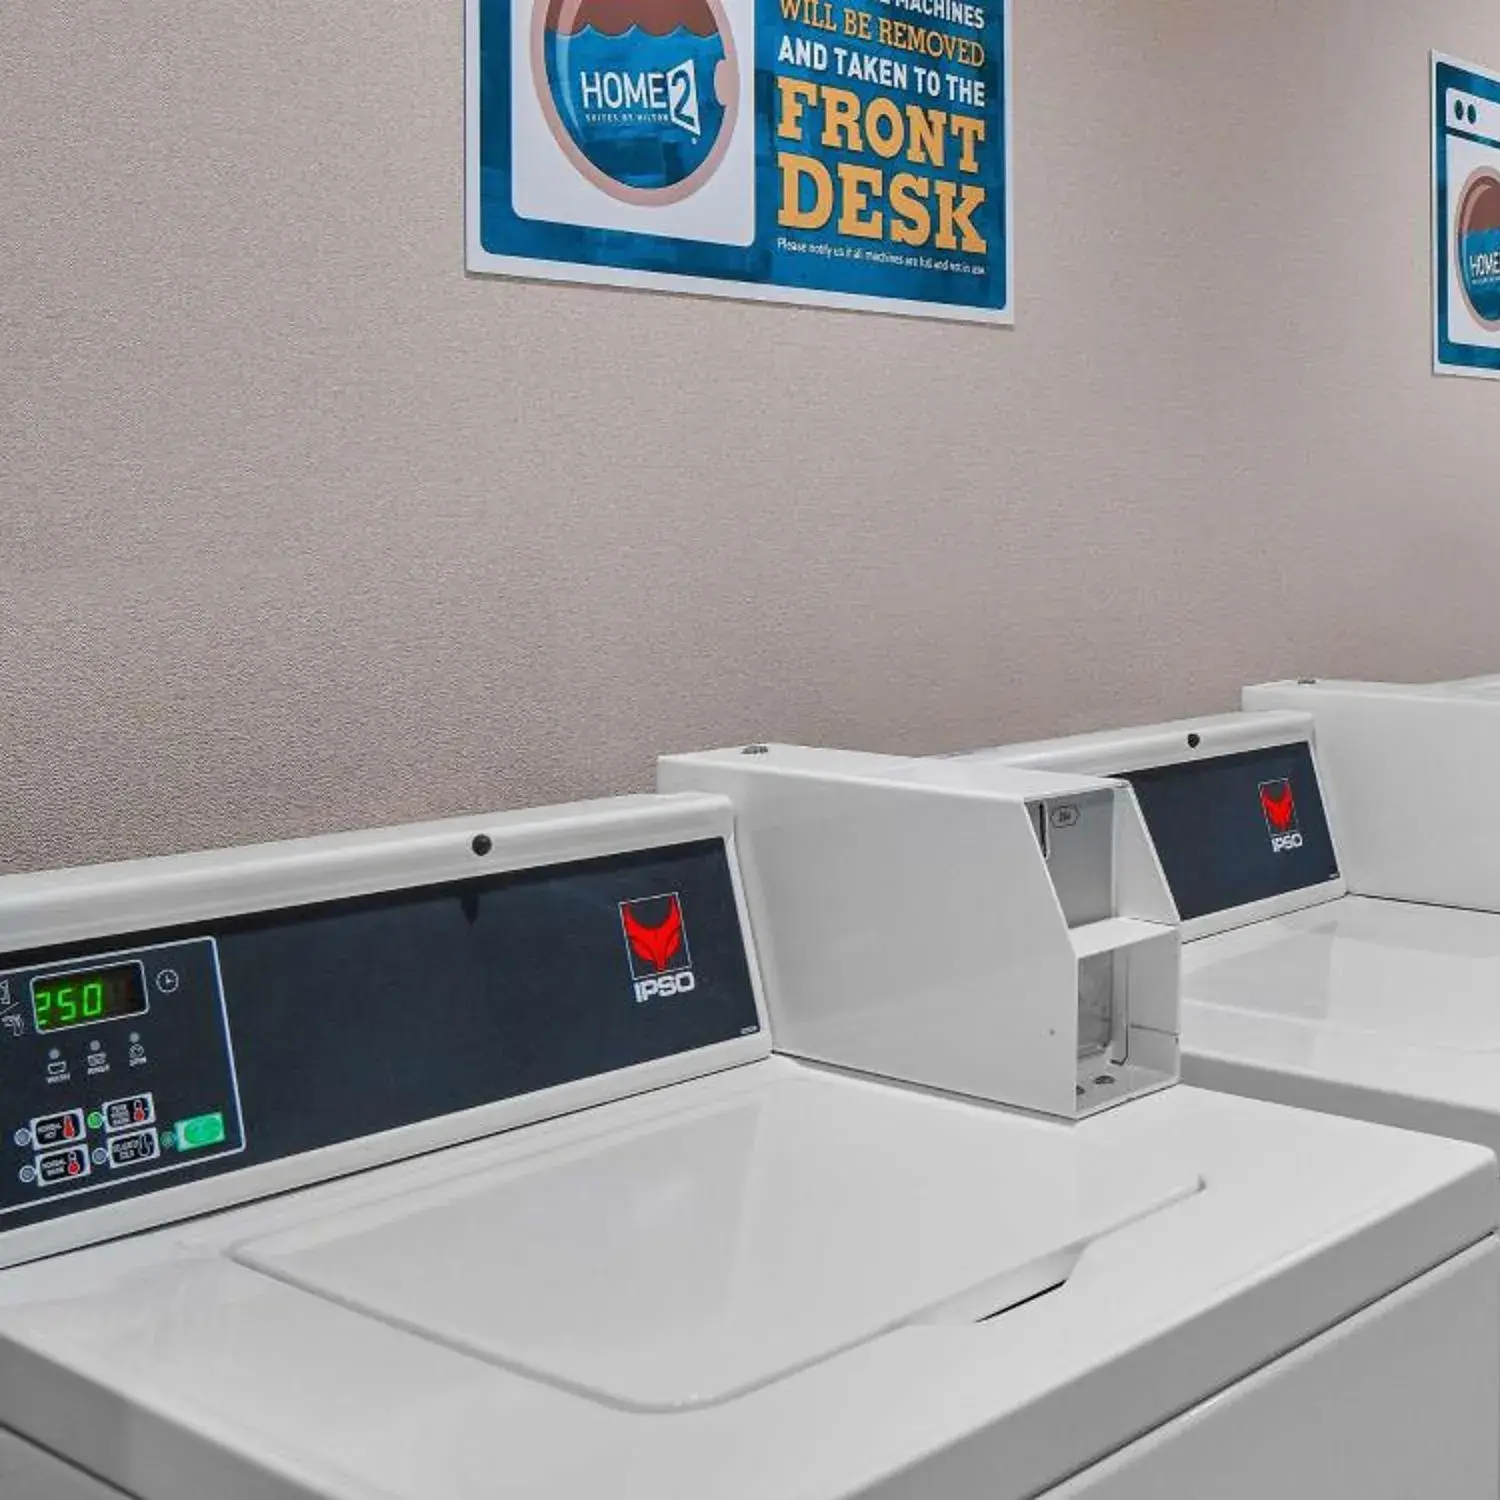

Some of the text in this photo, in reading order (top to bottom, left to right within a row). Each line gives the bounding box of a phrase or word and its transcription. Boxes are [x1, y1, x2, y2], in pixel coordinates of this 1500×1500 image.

[779, 0, 985, 67] WILL BE REMOVED
[778, 35, 985, 107] AND TAKEN TO THE
[777, 77, 987, 174] FRONT
[777, 151, 988, 255] DESK
[1271, 833, 1303, 853] IPSO
[633, 971, 696, 1003] IPSO
